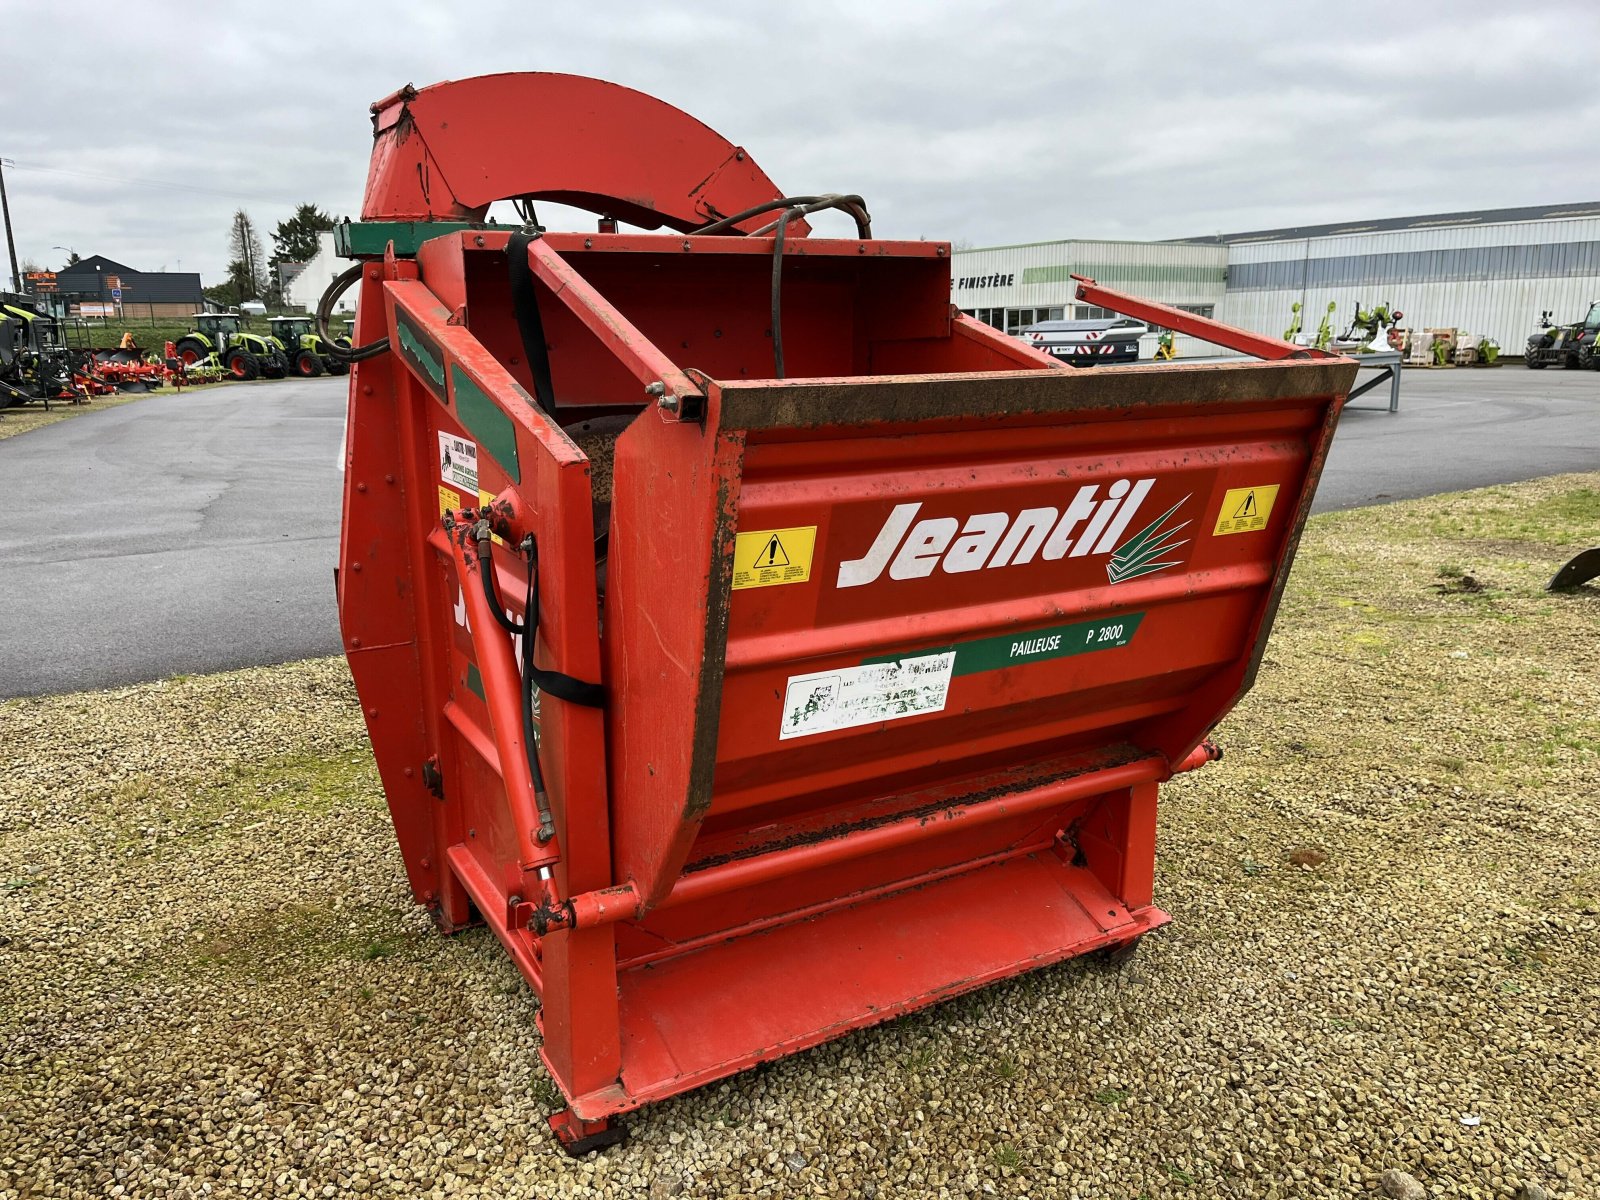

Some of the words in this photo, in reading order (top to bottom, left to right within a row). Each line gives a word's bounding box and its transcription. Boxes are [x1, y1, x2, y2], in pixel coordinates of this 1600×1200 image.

[958, 273, 1014, 290] FINISTÈRE
[836, 478, 1157, 588] Jeantil
[1010, 635, 1061, 657] PAILLEUSE
[1086, 629, 1094, 644] P
[1097, 624, 1123, 643] 2800
